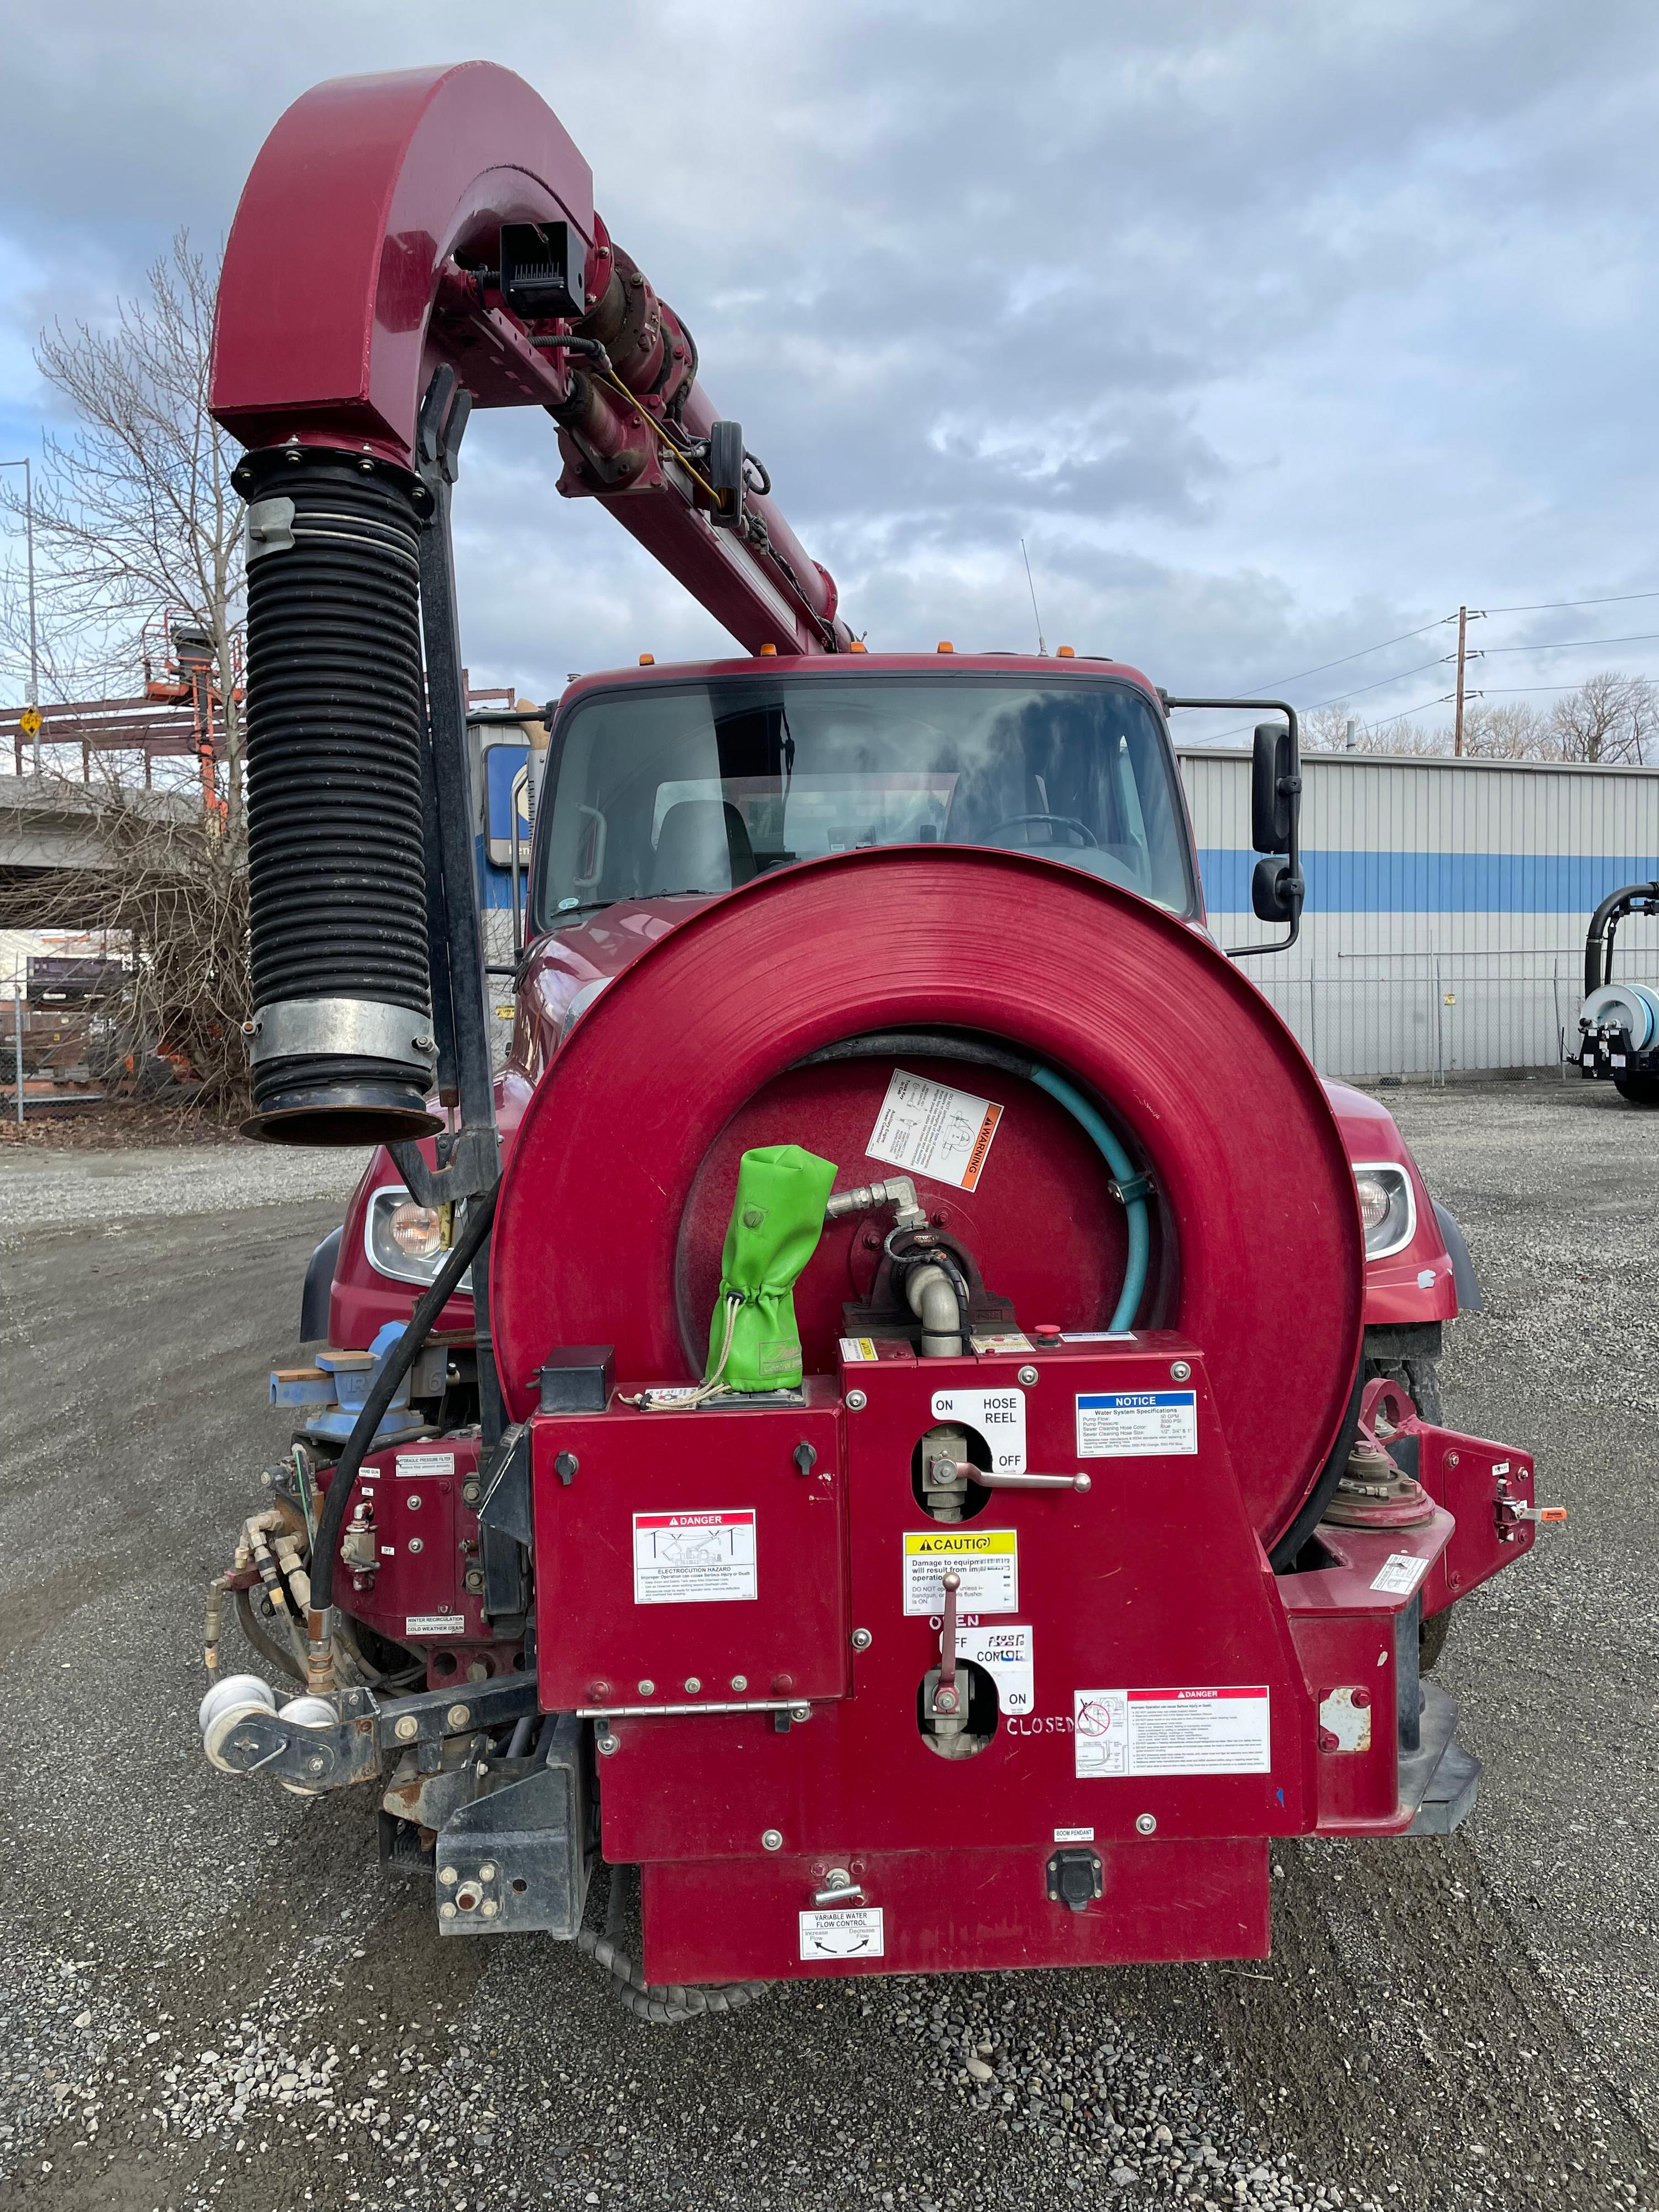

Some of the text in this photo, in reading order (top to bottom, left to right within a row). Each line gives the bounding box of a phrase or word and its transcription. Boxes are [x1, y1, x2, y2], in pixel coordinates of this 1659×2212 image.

[969, 1129, 990, 1173] WARNING
[429, 1369, 442, 1392] 6
[936, 1400, 953, 1410] ON
[984, 1398, 1016, 1408] HOSE
[1116, 1397, 1156, 1406] NOTICE
[986, 1413, 1016, 1423] REEL
[999, 1455, 1020, 1465] OFF
[680, 1516, 722, 1525] DANGER
[912, 1575, 943, 1583] operatio
[929, 1615, 979, 1630] OEN
[1010, 1694, 1026, 1704] ON
[1006, 1717, 1074, 1735] CLOSED
